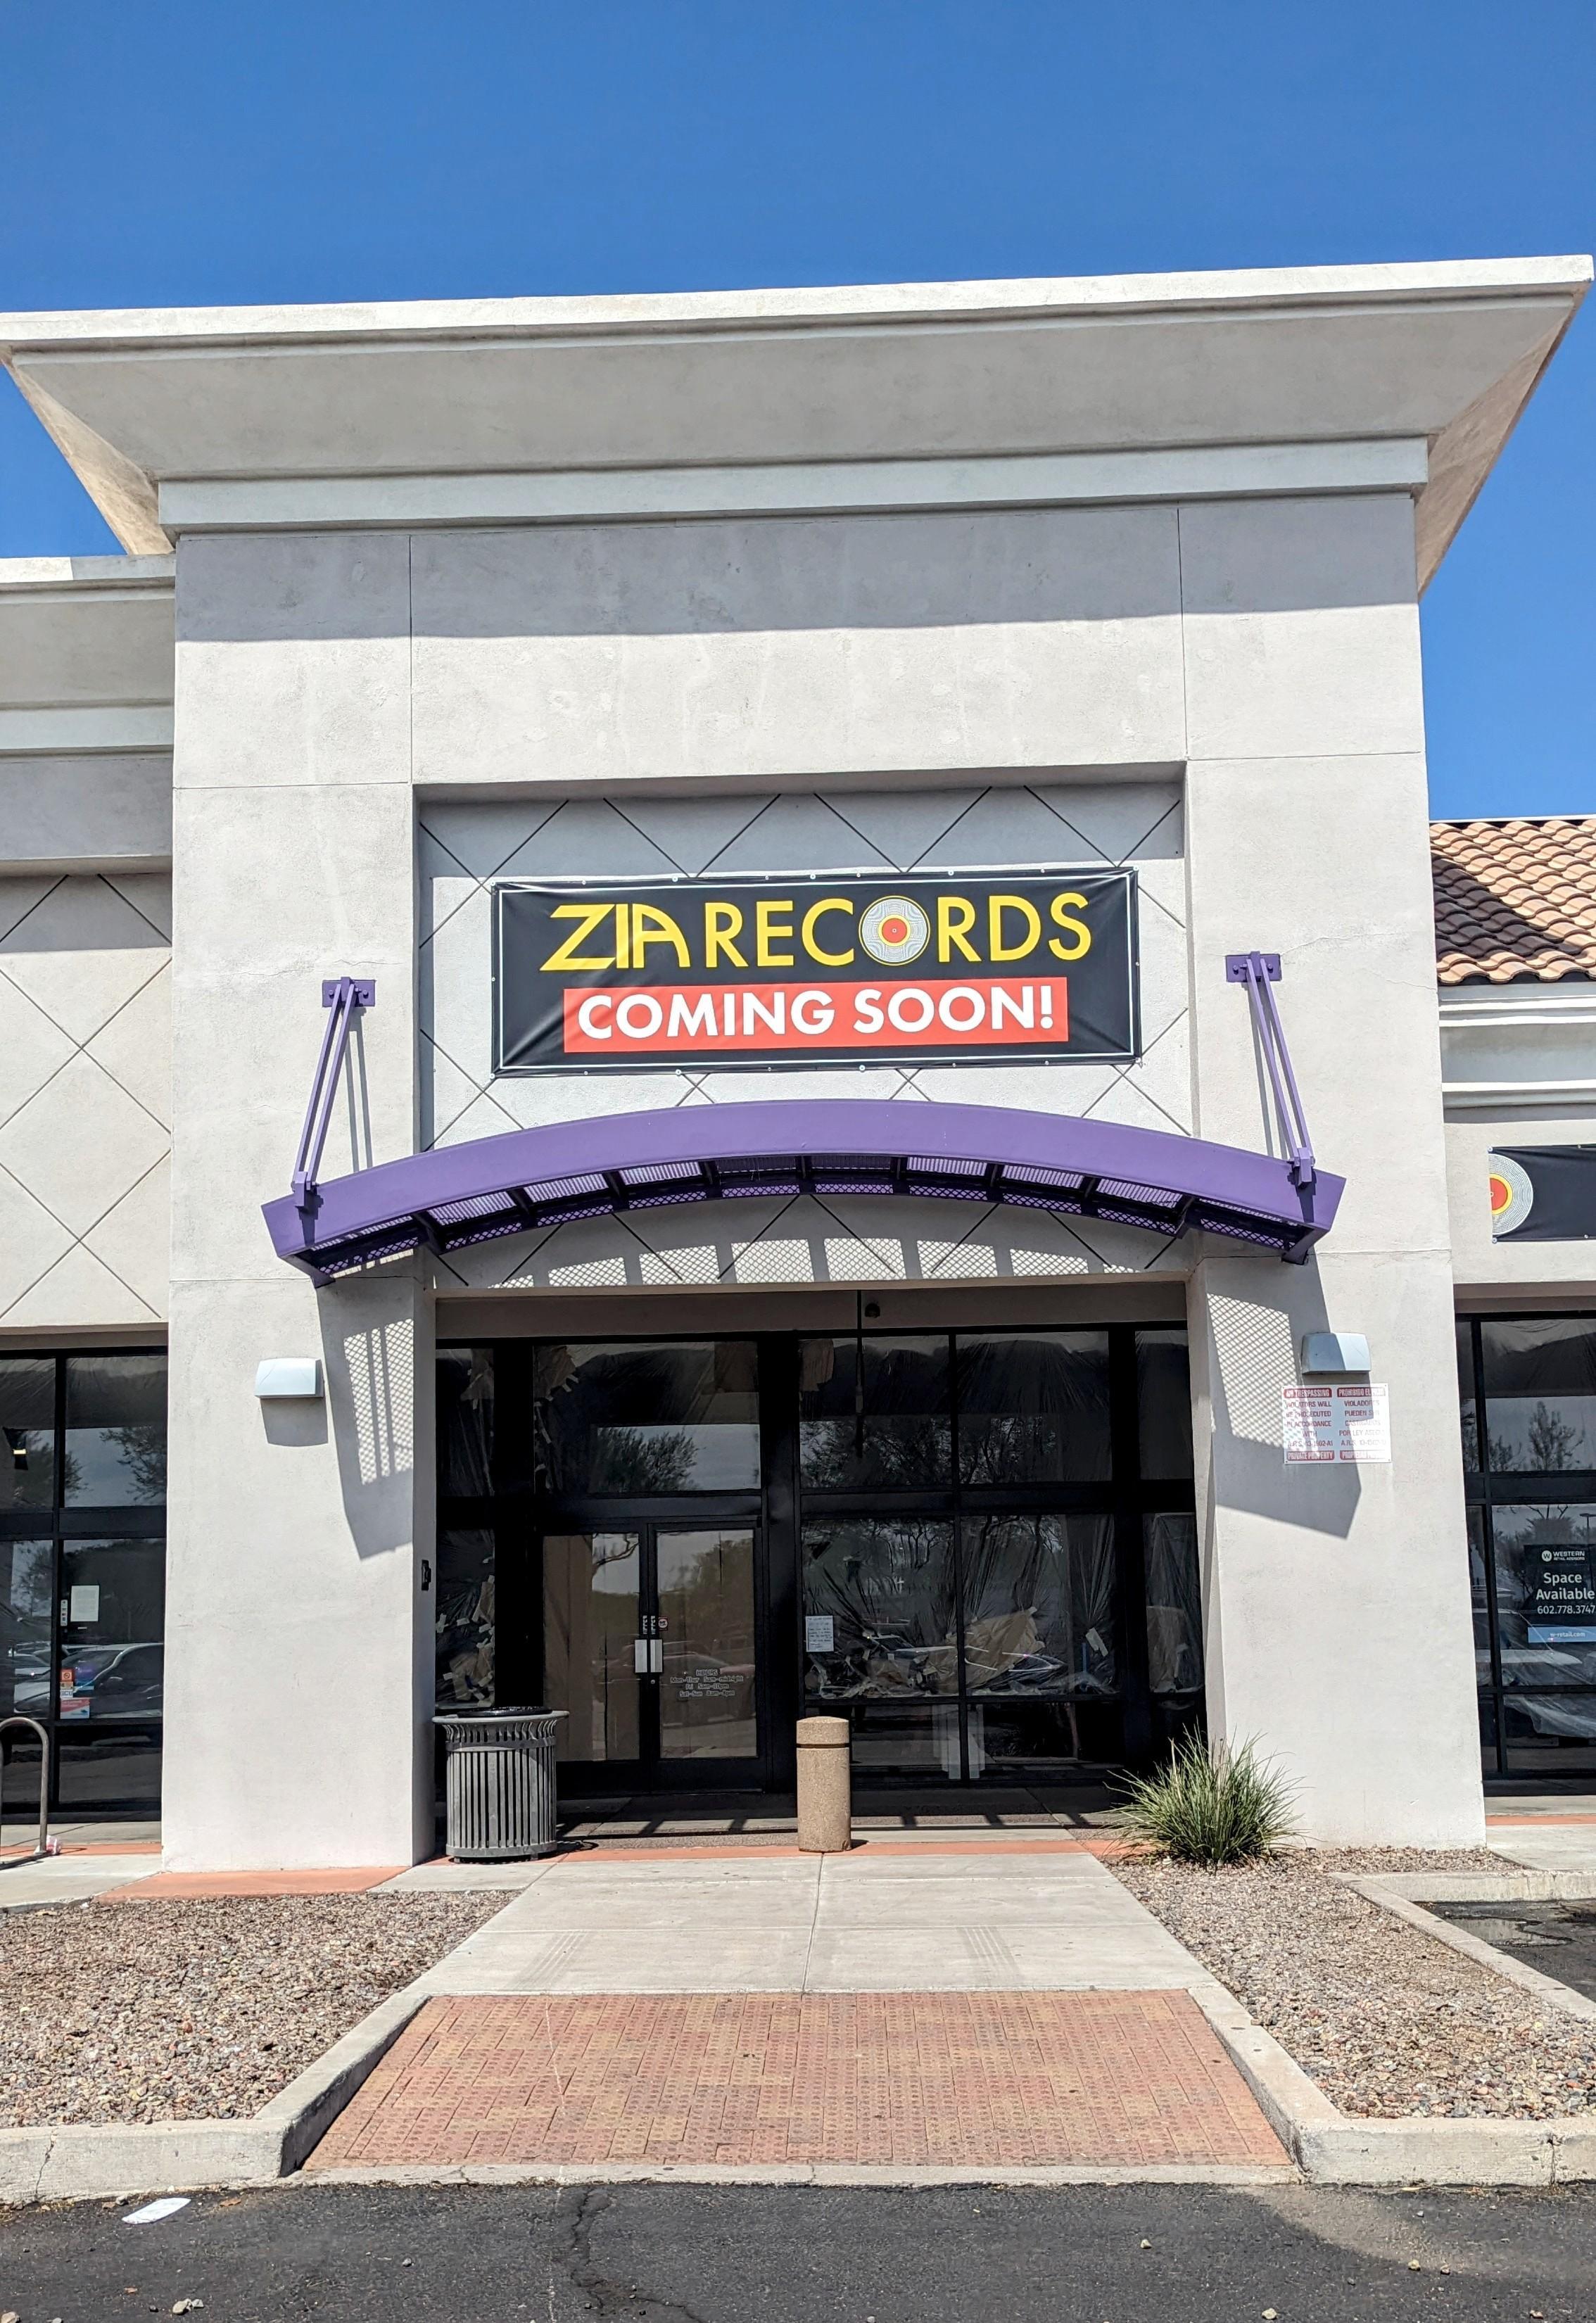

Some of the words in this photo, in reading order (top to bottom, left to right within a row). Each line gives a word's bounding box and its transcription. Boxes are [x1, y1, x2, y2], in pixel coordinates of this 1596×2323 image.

[540, 903, 691, 971] ZIA
[705, 892, 1092, 968] RECORDS
[577, 989, 835, 1042] COMING
[853, 985, 1054, 1034] SOON!
[1296, 1388, 1330, 1398] TRESPASSING
[1543, 1572, 1583, 1586] Space
[1535, 1588, 1595, 1600] Available
[1537, 1604, 1596, 1615] 602.778.3747
